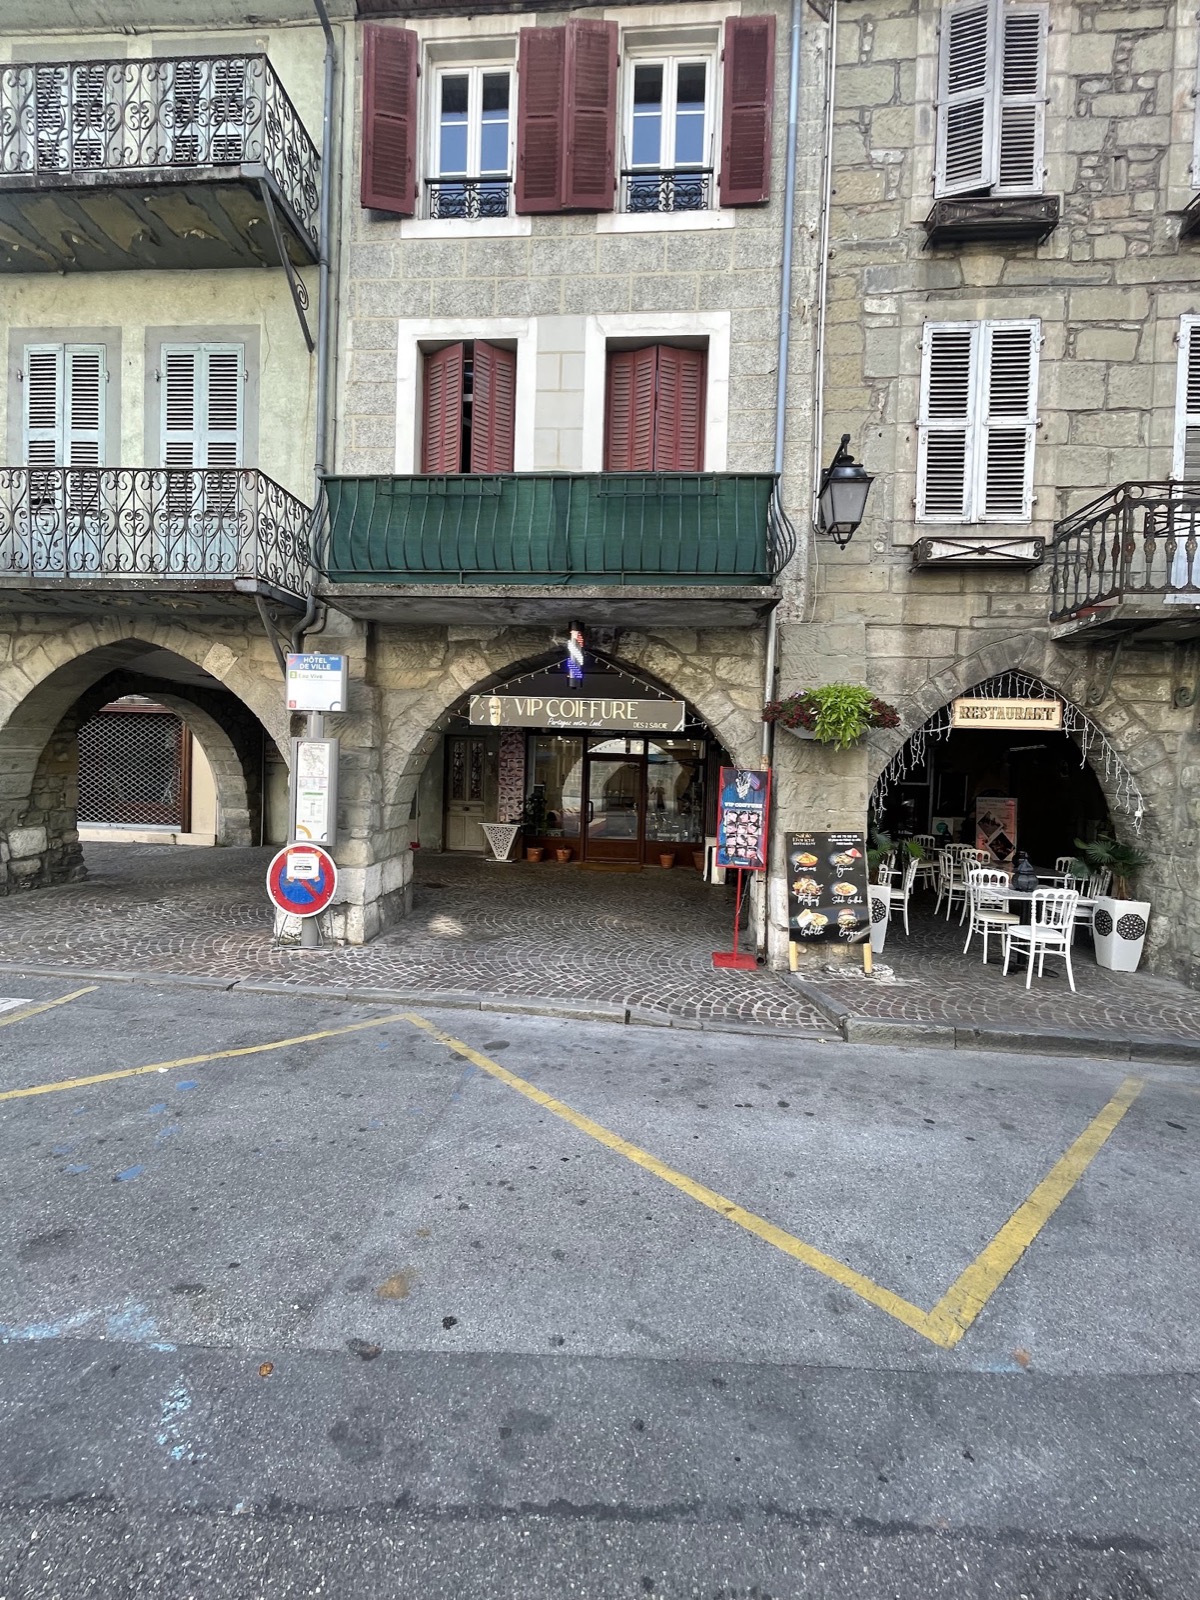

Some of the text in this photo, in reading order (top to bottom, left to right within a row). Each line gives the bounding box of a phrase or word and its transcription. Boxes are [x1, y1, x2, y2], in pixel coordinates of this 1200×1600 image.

[303, 655, 328, 664] HÔTEL
[514, 698, 638, 719] VIP COIFFURE
[959, 705, 1055, 720] RESTAURANT
